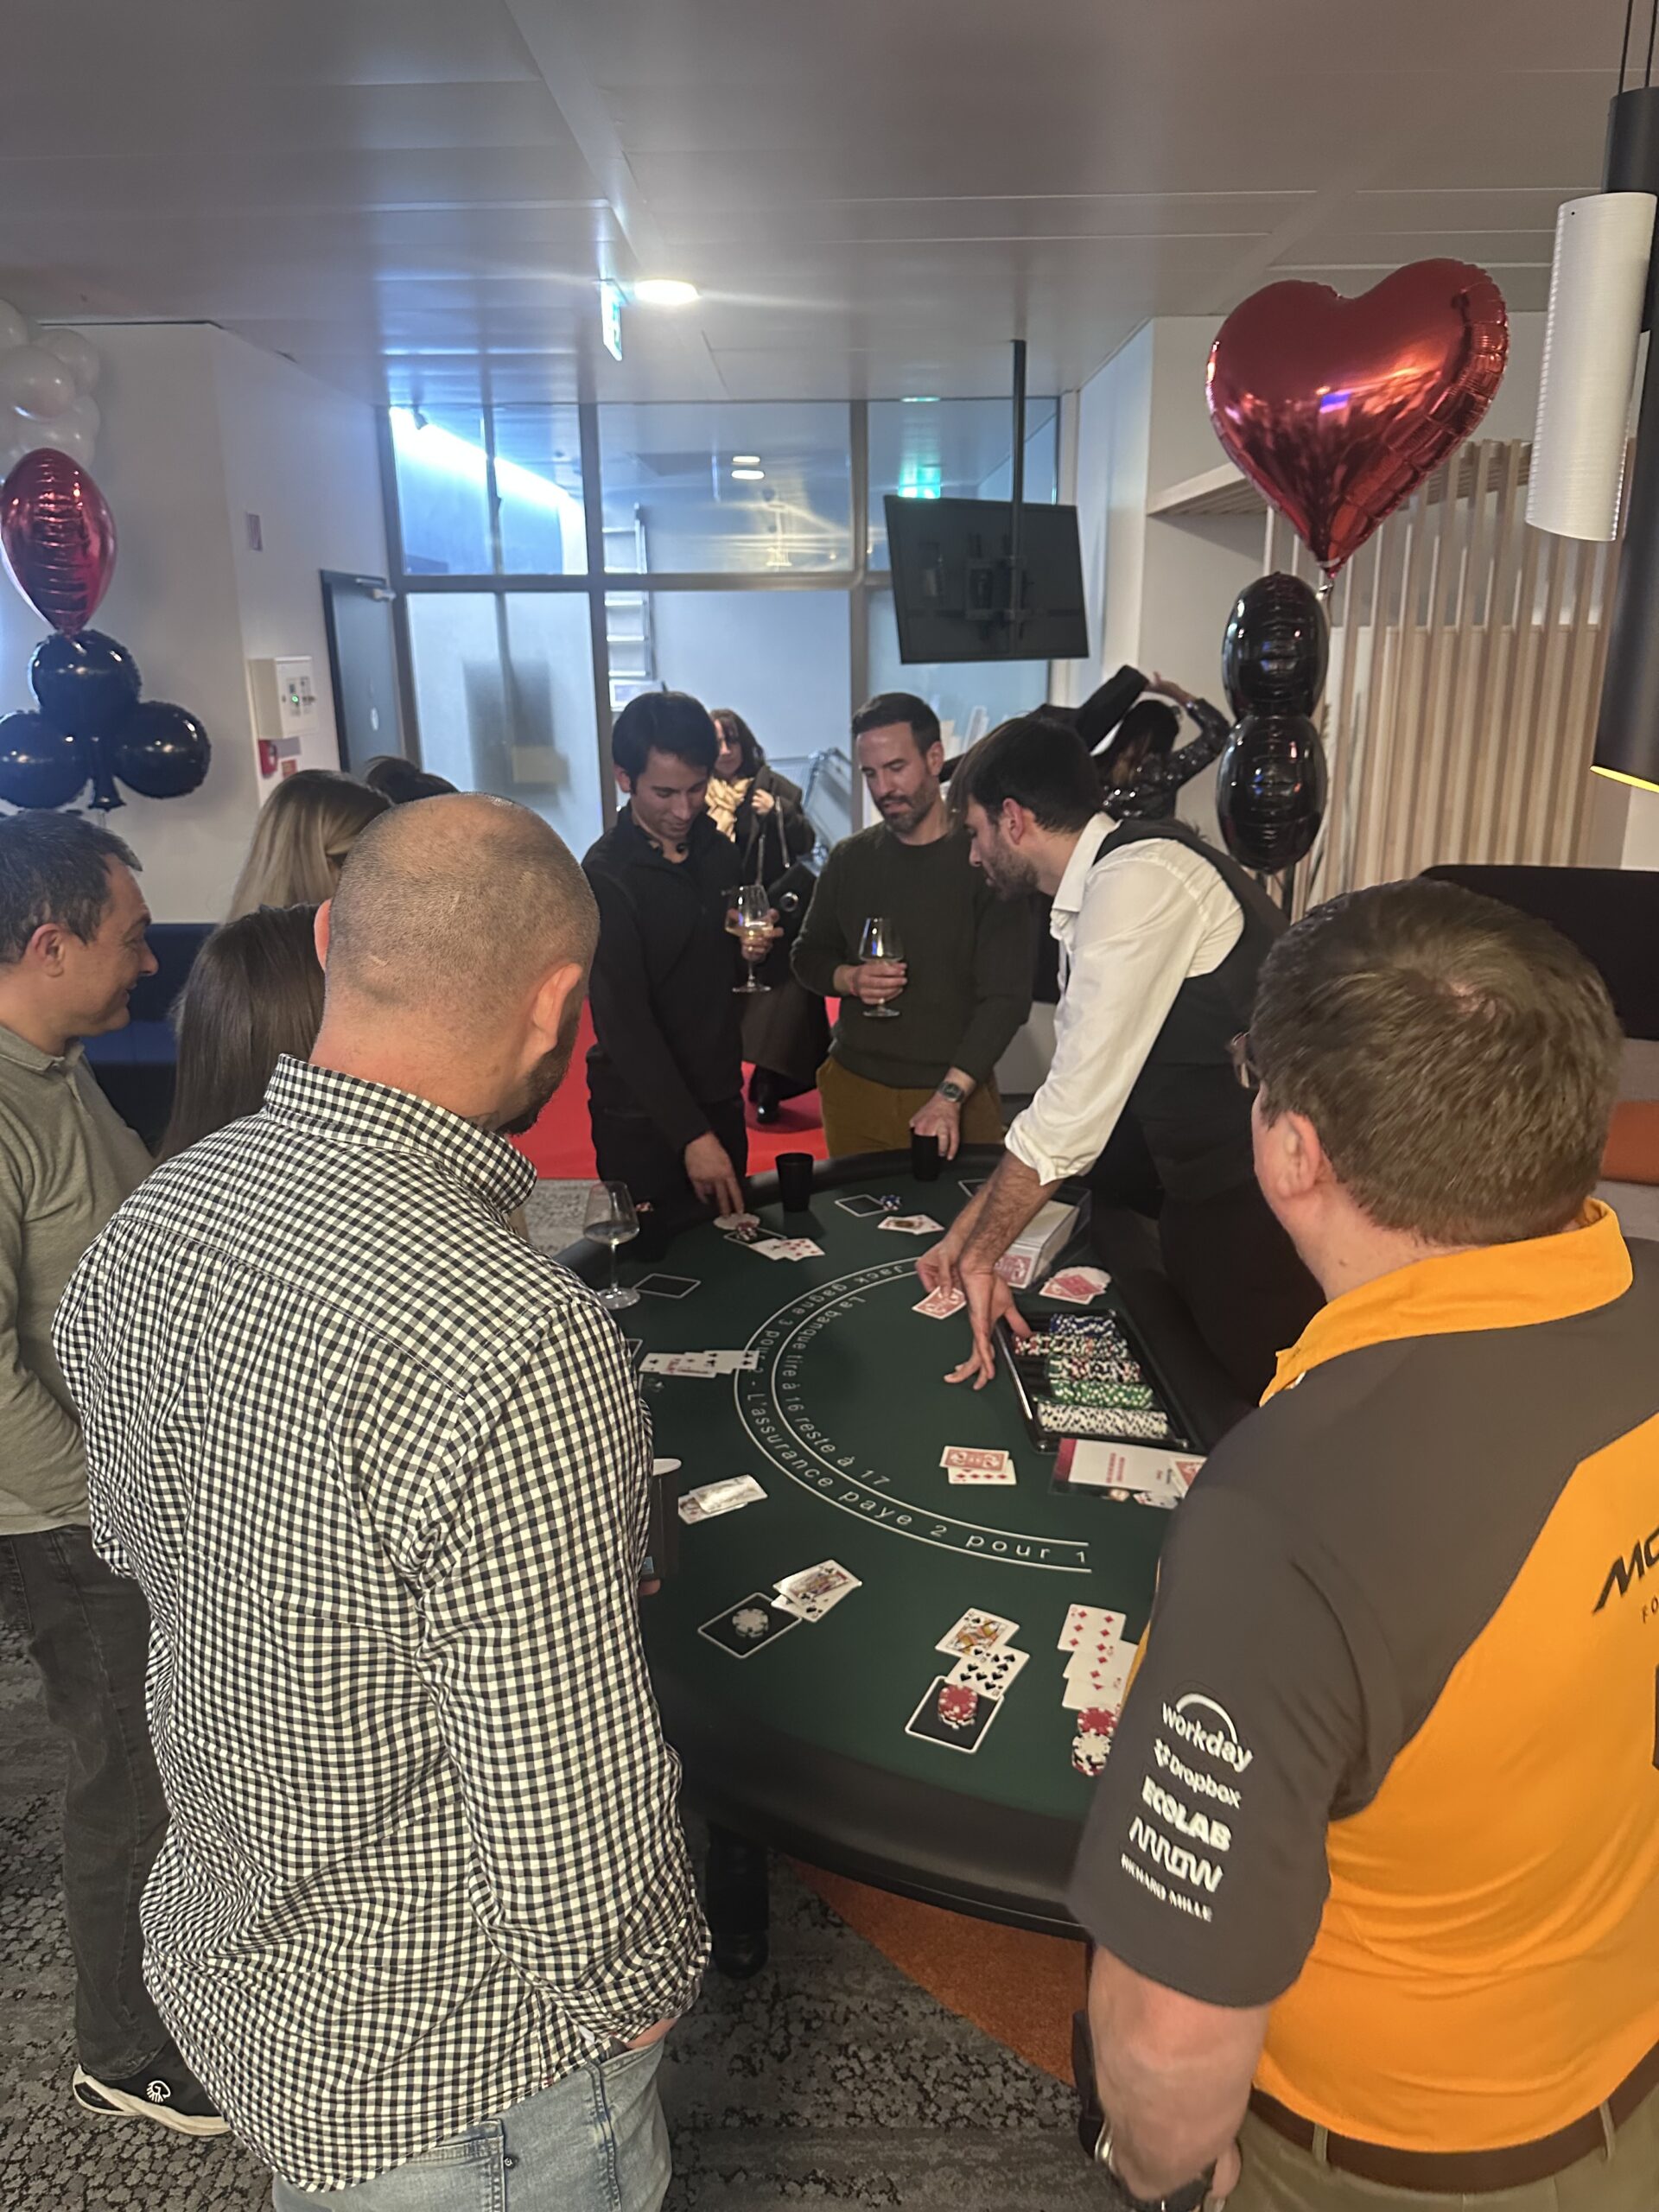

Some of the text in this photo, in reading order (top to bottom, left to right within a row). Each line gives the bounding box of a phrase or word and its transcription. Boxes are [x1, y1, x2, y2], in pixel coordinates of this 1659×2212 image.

[854, 1265, 904, 1284] Jack
[791, 1282, 848, 1315] gagne
[839, 1296, 866, 1308] La
[792, 1310, 842, 1349] banque
[782, 1355, 803, 1376] tire
[785, 1397, 804, 1411] 16
[747, 1394, 833, 1487] L'assurance
[795, 1417, 836, 1452] reste
[861, 1470, 891, 1485] 17
[838, 1491, 912, 1526] paye
[930, 1525, 947, 1537] 2
[965, 1535, 1051, 1559] pour
[1076, 1551, 1085, 1563] 1
[1162, 1702, 1253, 1772] workday
[1169, 1753, 1242, 1809] Dropbox
[1141, 1775, 1232, 1852] ECOLAB
